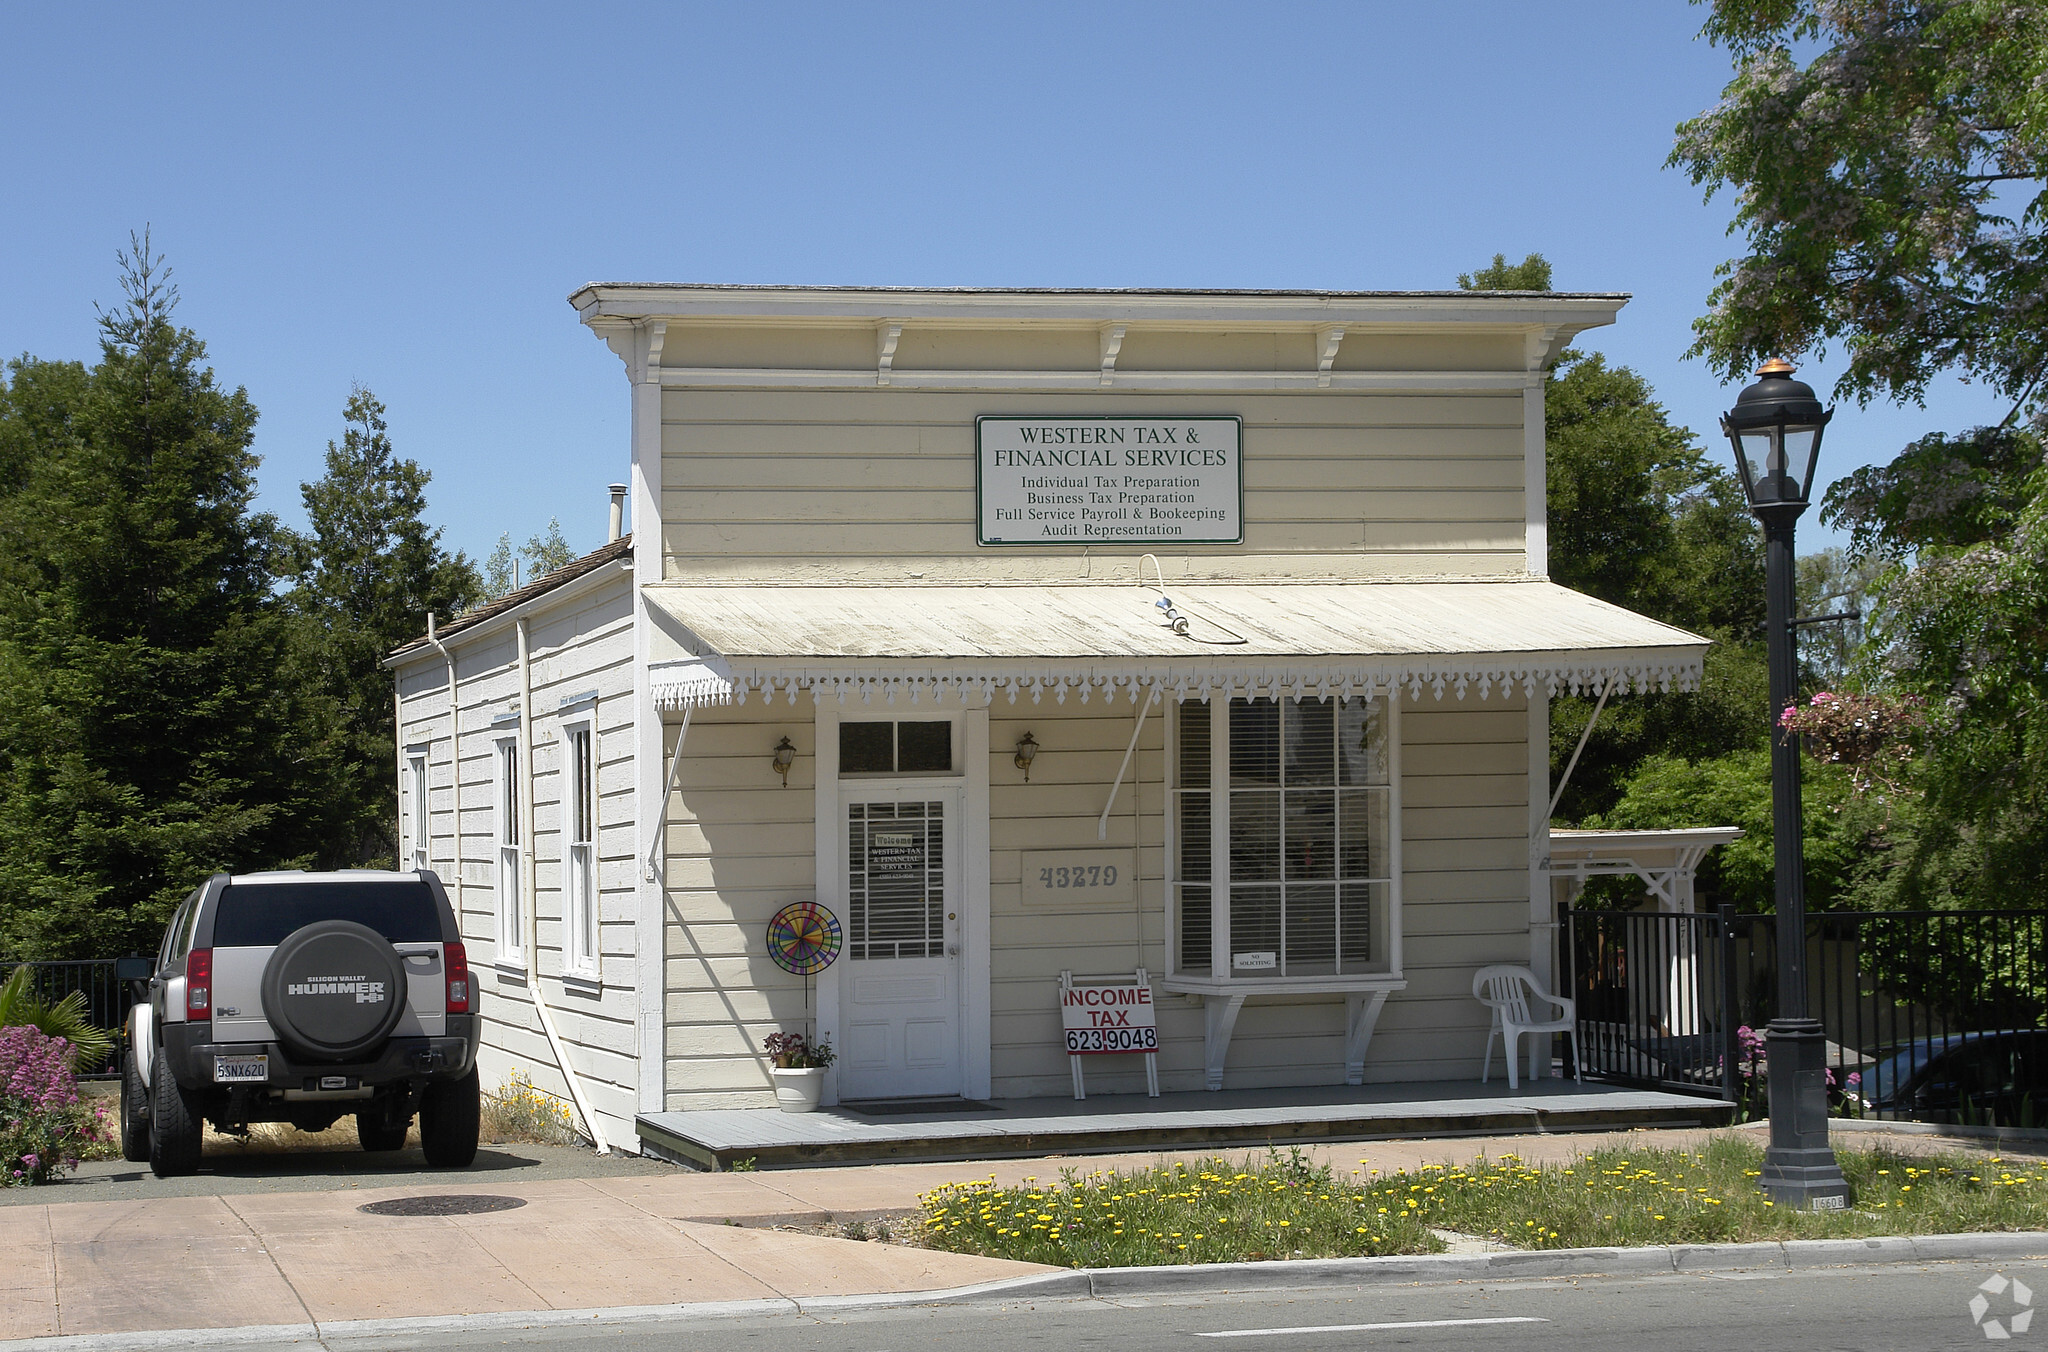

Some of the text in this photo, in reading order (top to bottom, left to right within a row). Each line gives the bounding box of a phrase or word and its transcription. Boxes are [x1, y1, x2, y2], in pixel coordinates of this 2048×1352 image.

[1020, 427, 1200, 444] WESTERN TAX &
[994, 449, 1227, 467] FINANCIAL SERVICES
[1021, 476, 1200, 490] Individual Tax Preparation
[1027, 492, 1195, 506] Business Tax Preparation
[996, 507, 1226, 523] Full Service Payroll & Bookeeping
[1041, 524, 1182, 539] Audit Representation
[877, 836, 912, 845] Welcome
[1039, 865, 1118, 889] 43279
[288, 982, 385, 995] HUMMER
[1063, 988, 1151, 1007] INCOME
[1087, 1010, 1130, 1027] TAX
[218, 1064, 265, 1078] 5SNX620
